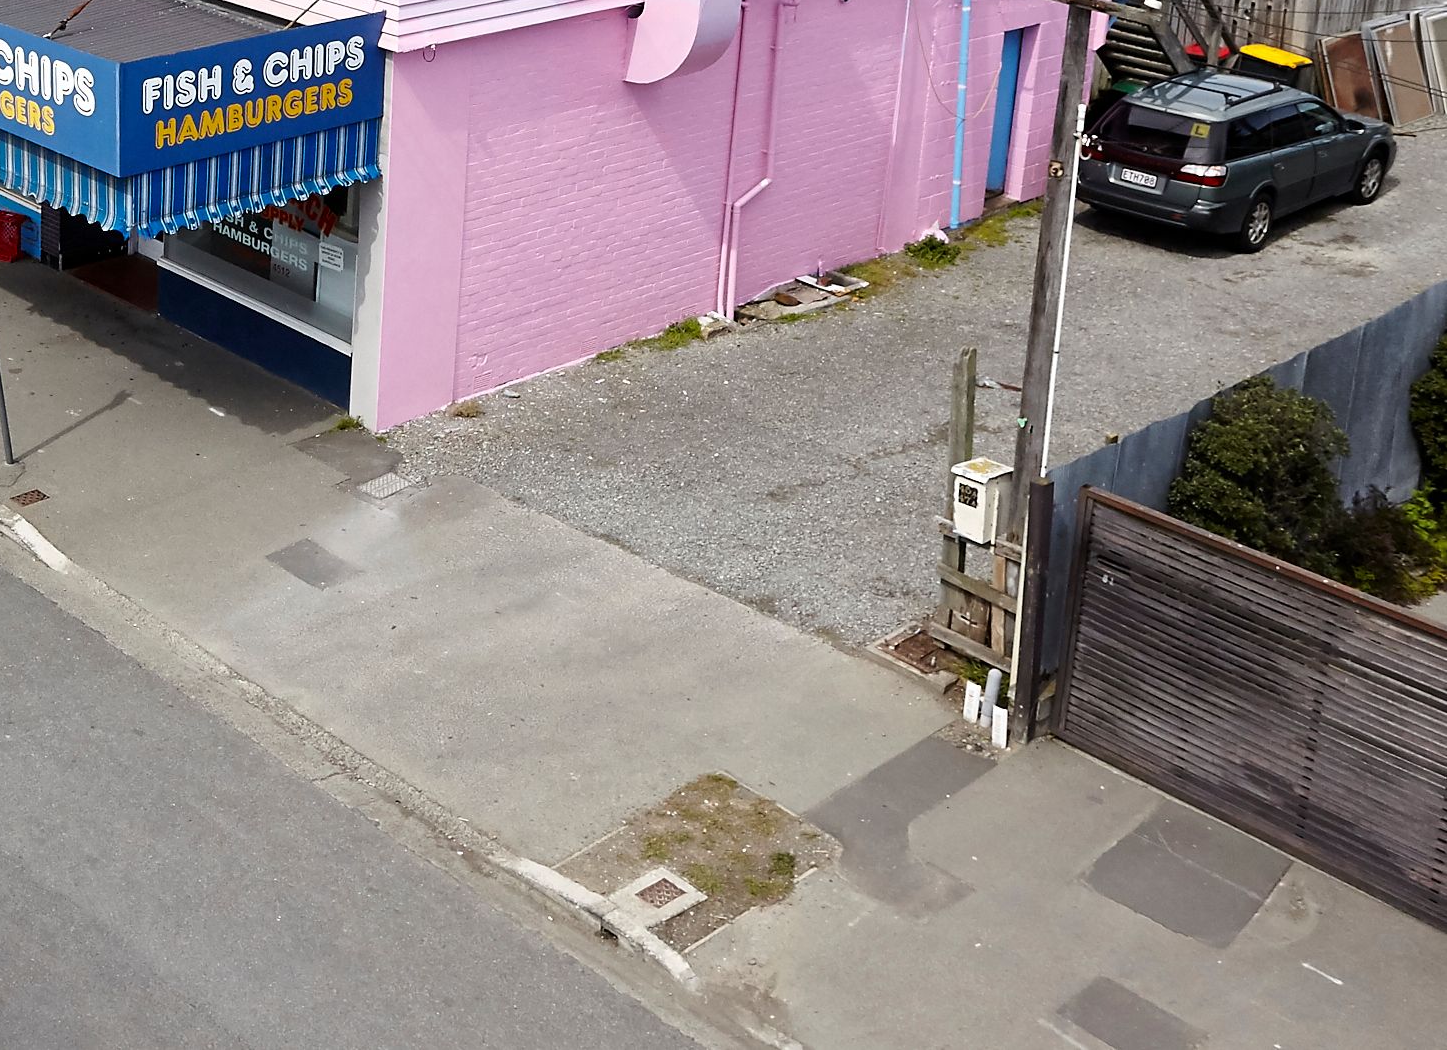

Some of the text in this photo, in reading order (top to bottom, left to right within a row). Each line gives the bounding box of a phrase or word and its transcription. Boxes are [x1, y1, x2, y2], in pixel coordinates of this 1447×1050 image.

[142, 35, 365, 115] FISH & CHIPS
[155, 78, 354, 149] HAMBURGERS
[1194, 125, 1203, 136] L
[213, 222, 308, 271] HAMBURGERS
[248, 220, 259, 234] &
[263, 226, 308, 254] CHIPS
